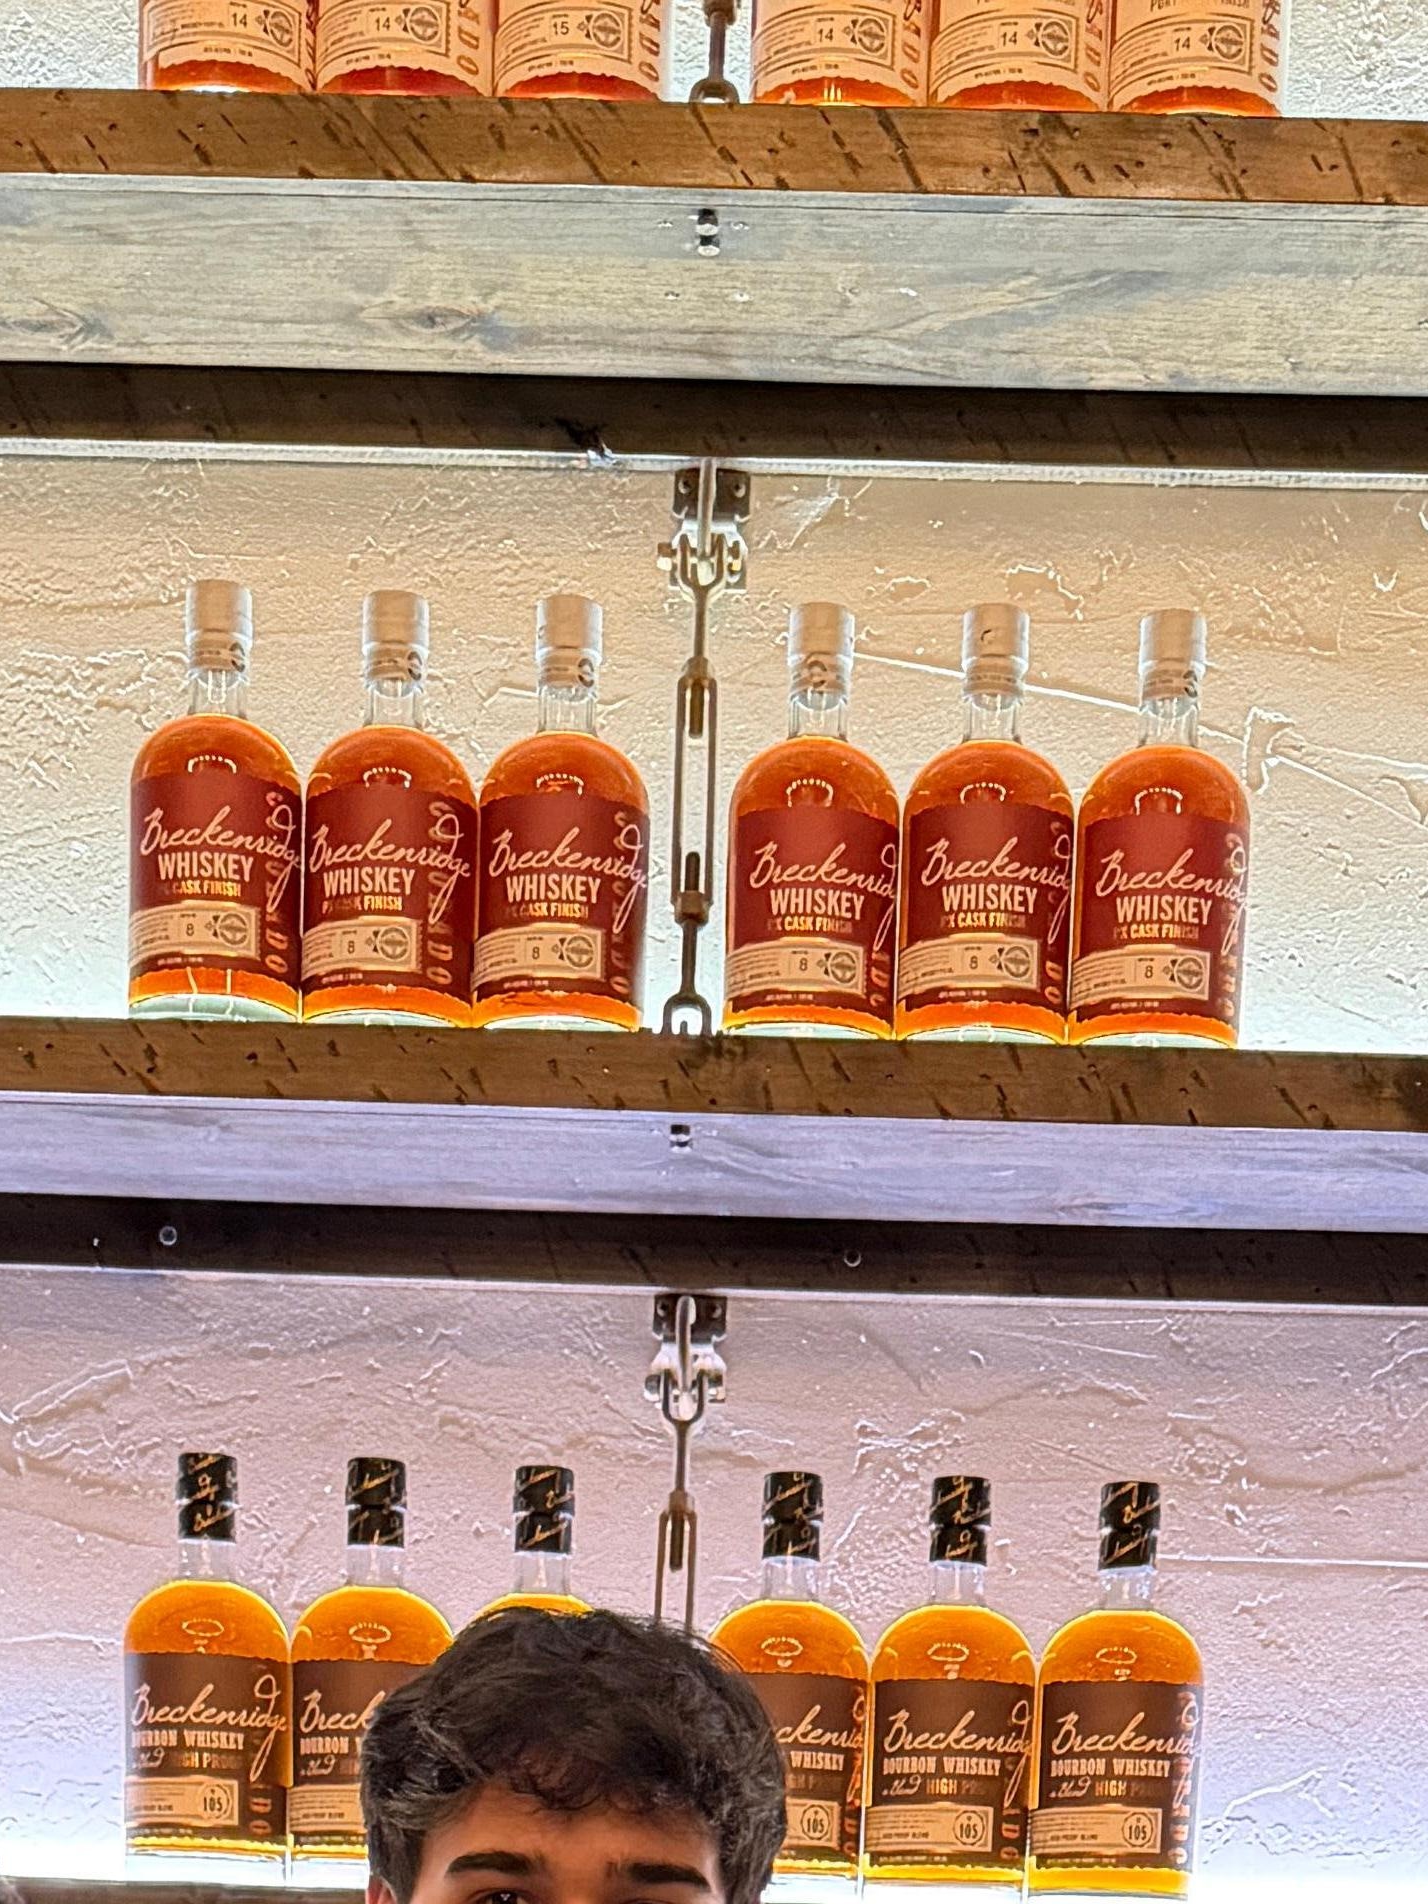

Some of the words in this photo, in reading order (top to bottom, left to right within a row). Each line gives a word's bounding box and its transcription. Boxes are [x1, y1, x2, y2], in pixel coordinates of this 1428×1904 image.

[230, 13, 248, 29] 14
[374, 16, 390, 32] 14
[553, 20, 570, 36] 15
[817, 27, 834, 44] 14
[1000, 30, 1019, 47] 14
[1173, 35, 1191, 52] 14
[157, 851, 254, 882] WHISKEY
[310, 813, 471, 925] Breckenridge
[203, 881, 243, 898] FINISH
[323, 866, 416, 898] WHISKEY
[506, 874, 601, 903] WHISKEY
[364, 894, 403, 912] FINISH
[770, 888, 865, 920] WHISKEY
[942, 883, 1037, 914] WHISKEY
[1116, 894, 1212, 925] WHISKEY
[784, 916, 813, 932] CASK
[958, 912, 986, 928] CASK
[186, 923, 195, 937] 8
[1130, 923, 1160, 938] CASK
[347, 940, 355, 954] 8
[532, 946, 541, 960] 8
[799, 958, 808, 972] 8
[1145, 965, 1154, 979] 8
[183, 1731, 245, 1750] WHISKEY
[300, 1737, 349, 1755] BOURBON
[791, 1751, 845, 1771] WHISKEY
[883, 1756, 937, 1775] BOURBON
[943, 1756, 1001, 1776] WHISKEY
[1051, 1757, 1106, 1778] BOURBON
[1112, 1759, 1171, 1778] WHISKEY
[926, 1778, 958, 1794] HIGH
[1095, 1780, 1127, 1797] HIGH
[203, 1796, 222, 1812] 105
[806, 1818, 825, 1833] 105
[959, 1823, 979, 1838] 105
[1128, 1824, 1148, 1841] 105
